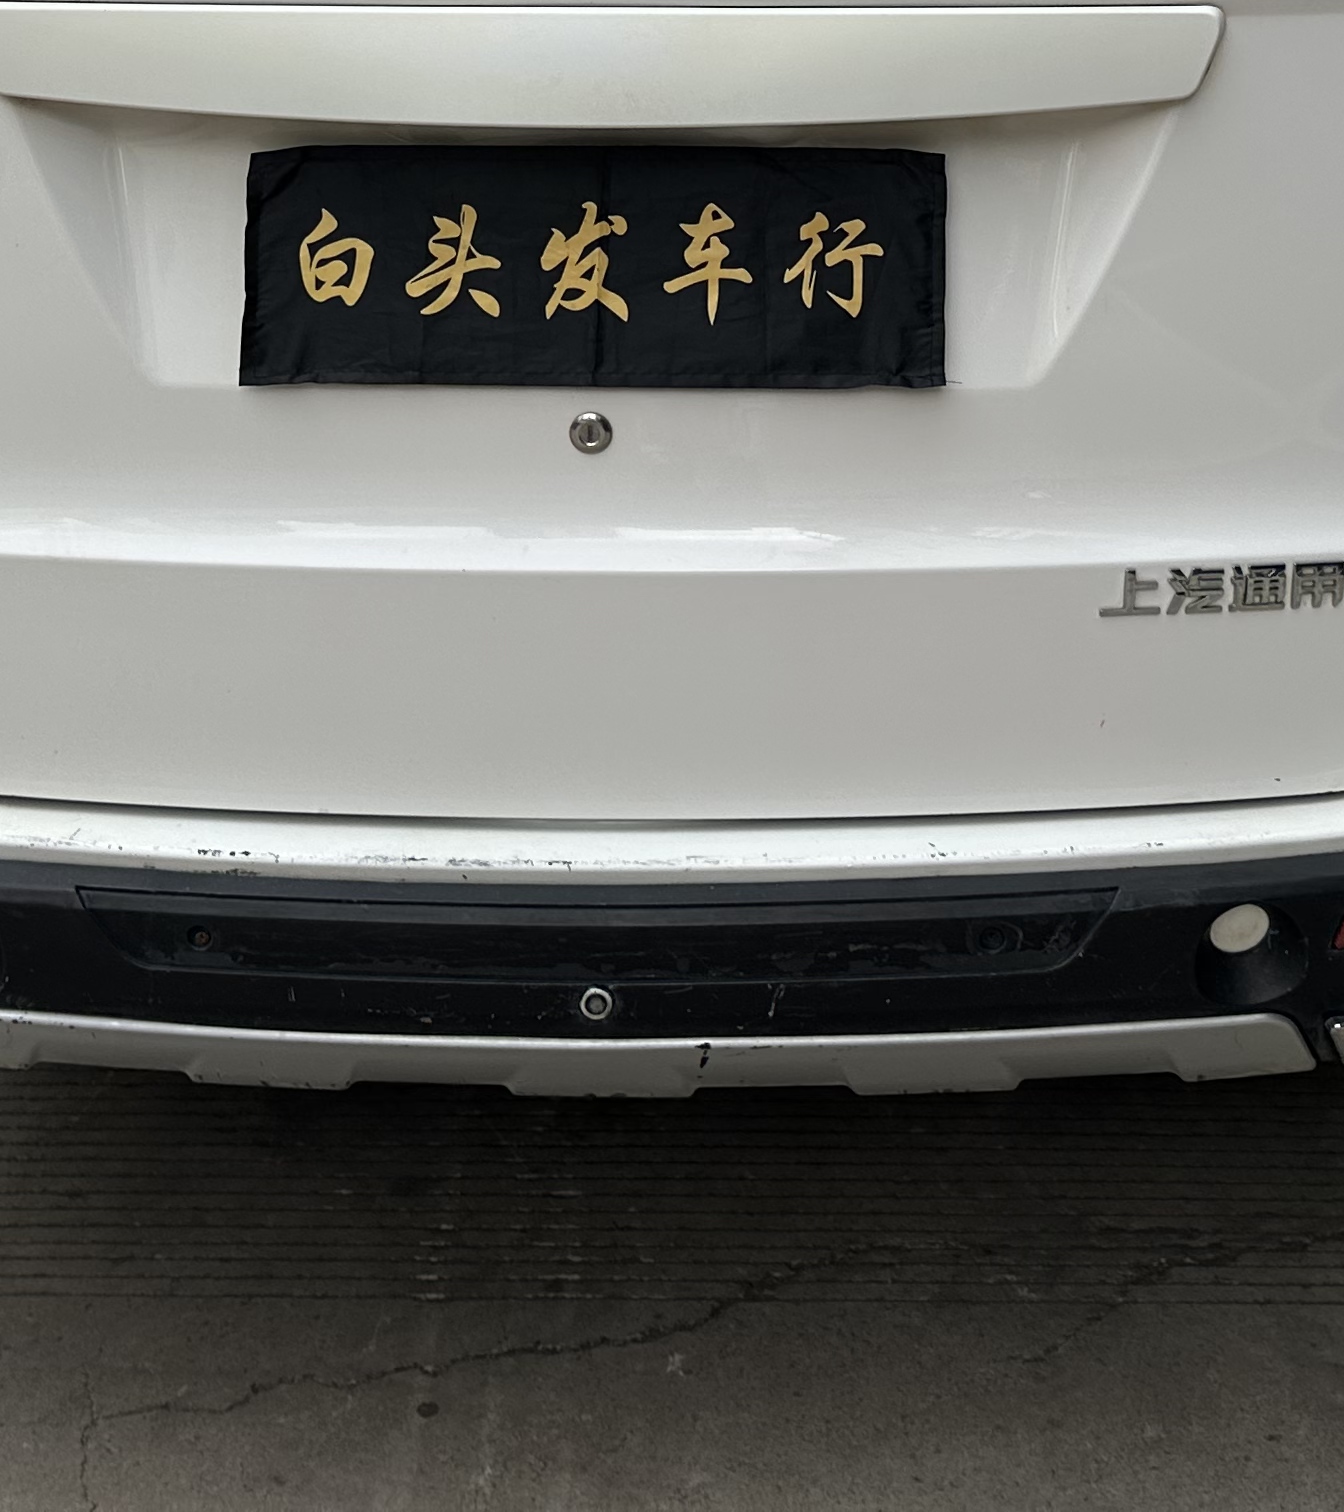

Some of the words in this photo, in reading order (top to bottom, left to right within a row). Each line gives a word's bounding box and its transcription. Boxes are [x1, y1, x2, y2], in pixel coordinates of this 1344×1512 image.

[299, 201, 884, 325] 白头发车行
